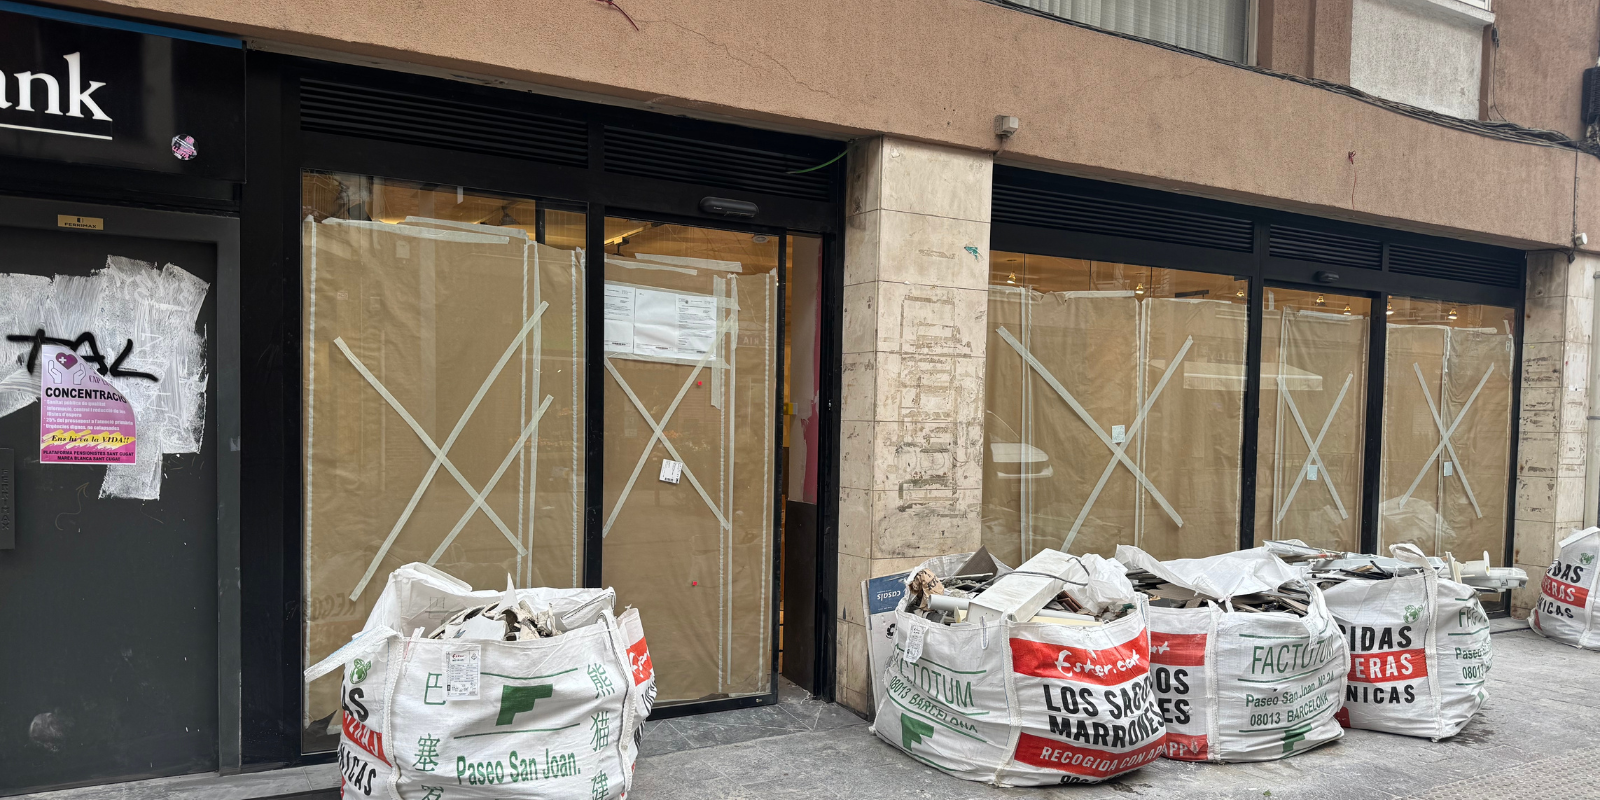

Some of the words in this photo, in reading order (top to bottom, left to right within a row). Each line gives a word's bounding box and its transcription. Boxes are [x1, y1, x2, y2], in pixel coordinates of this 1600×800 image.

[52, 434, 67, 442] Ens
[102, 436, 130, 444] VIDA!!
[877, 590, 901, 601] casals
[1355, 653, 1413, 679] ERAS
[889, 655, 974, 708] CTOTUM
[890, 675, 912, 699] 08013
[1346, 684, 1416, 704] NICAS
[1042, 684, 1099, 717] LOS
[1246, 693, 1279, 707] Paseo
[1282, 691, 1298, 704] San
[1250, 712, 1281, 727] 08013
[1286, 692, 1329, 723] BARCELONA
[1048, 700, 1165, 748] MARRONES
[456, 755, 505, 786] Paseo
[509, 750, 539, 783] San
[542, 748, 581, 777] Joan.
[1040, 746, 1117, 772] RECOGIDA
[1119, 752, 1145, 769] CON
